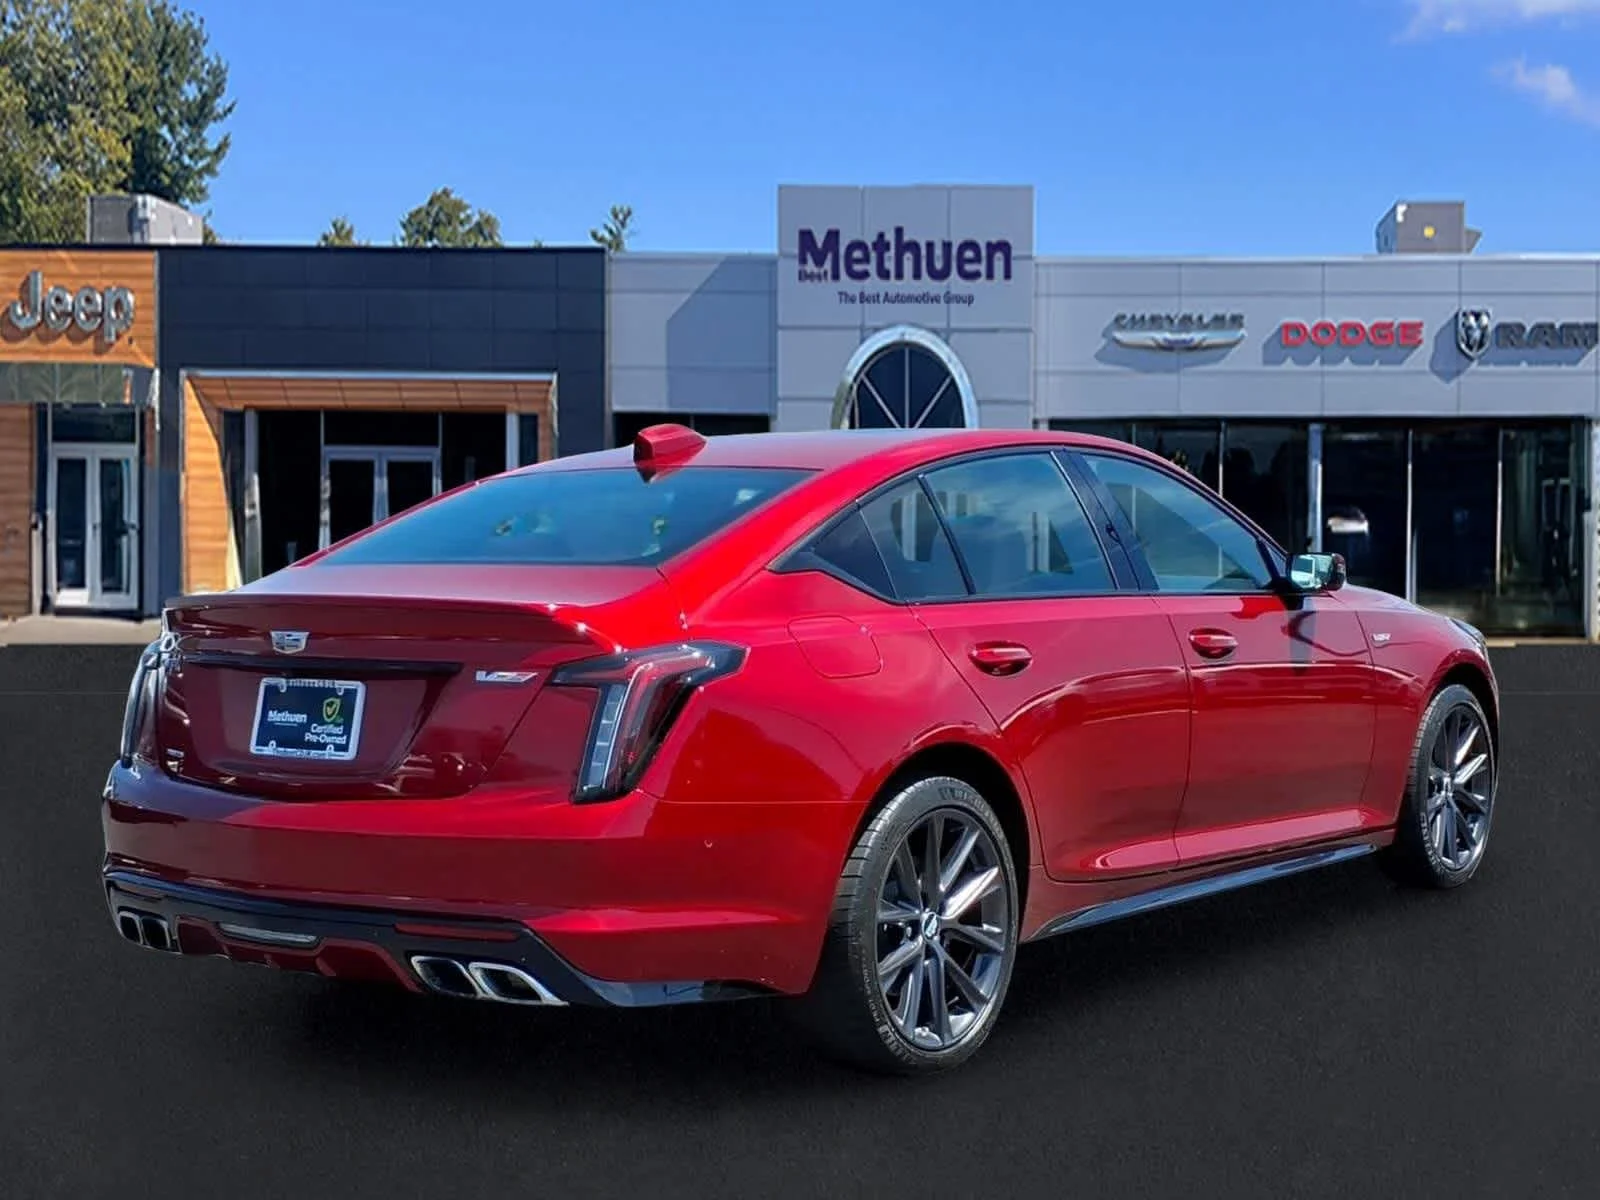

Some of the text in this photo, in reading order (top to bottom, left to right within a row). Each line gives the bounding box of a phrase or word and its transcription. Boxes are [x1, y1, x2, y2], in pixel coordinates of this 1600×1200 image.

[798, 226, 1012, 281] Methuen
[9, 271, 135, 343] Jeep
[838, 291, 974, 307] The Best Automotive Group
[1281, 321, 1424, 347] DODGE
[1495, 322, 1599, 349] RAM
[268, 710, 307, 723] Methuen
[305, 732, 348, 744] Pre-Owned
[311, 723, 344, 734] Certified
